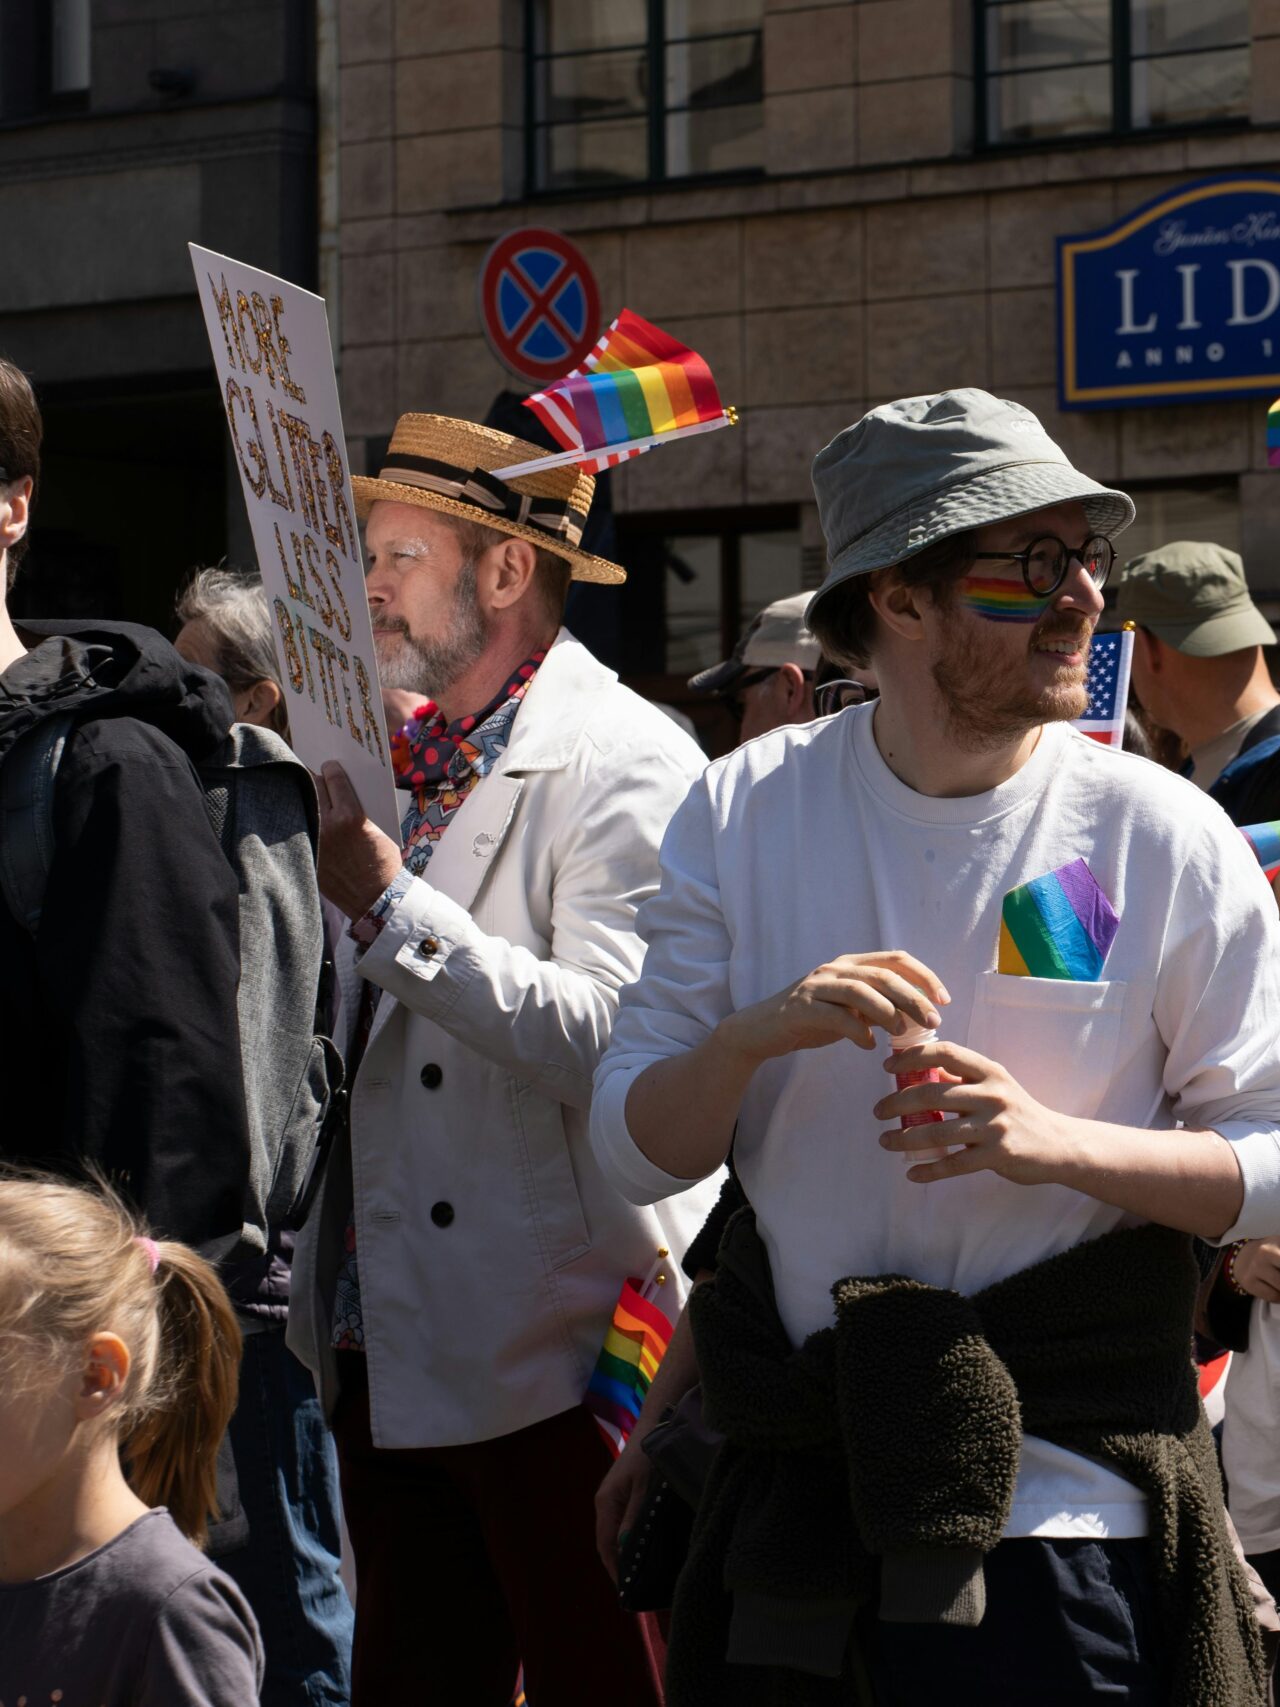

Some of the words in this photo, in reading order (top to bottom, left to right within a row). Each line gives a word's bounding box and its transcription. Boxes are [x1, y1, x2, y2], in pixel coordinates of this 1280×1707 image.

[207, 271, 307, 405] MORE
[1116, 342, 1225, 369] ANNO
[226, 376, 358, 563] GLITTER
[273, 522, 351, 642] LESS
[273, 594, 386, 768] BITTER
